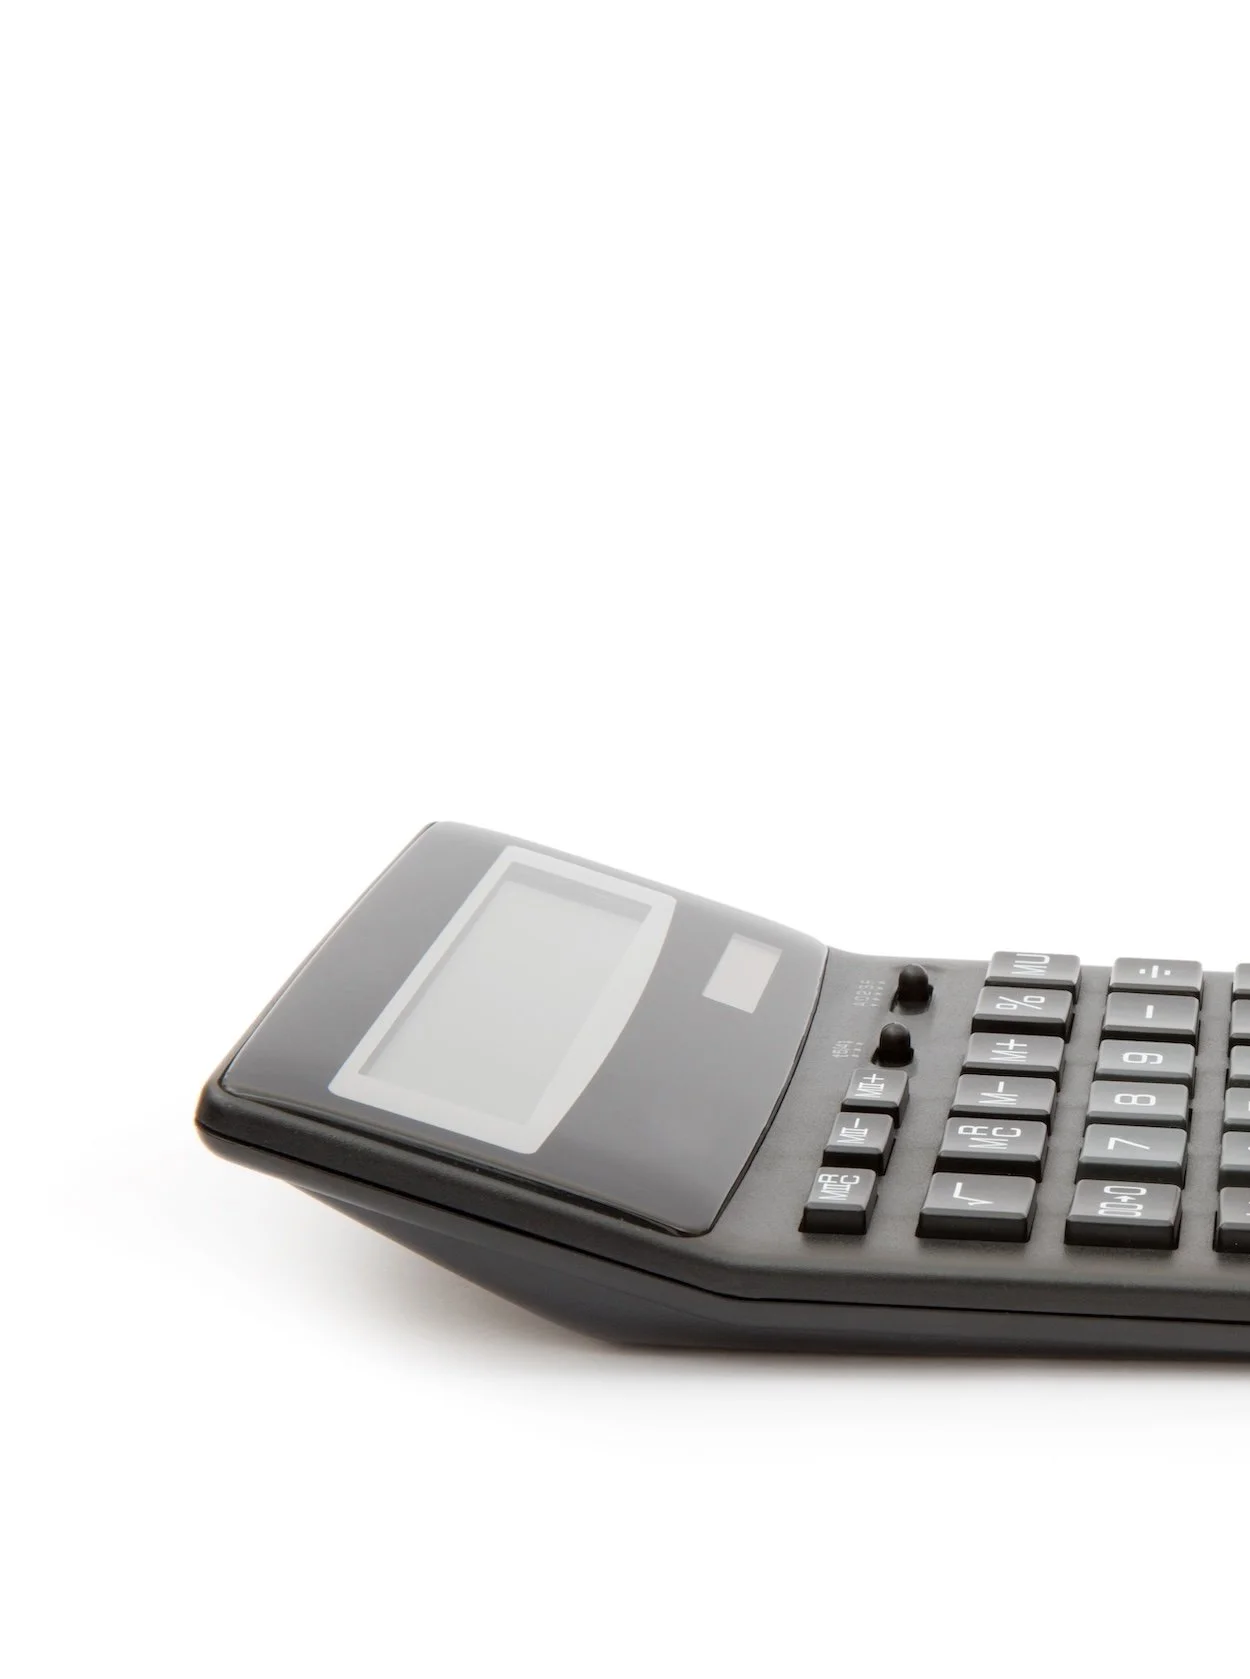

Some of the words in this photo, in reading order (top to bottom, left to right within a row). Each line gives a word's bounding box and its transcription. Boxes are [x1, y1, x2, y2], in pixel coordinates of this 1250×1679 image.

[995, 995, 1046, 1010] %
[990, 1038, 1029, 1064] M+
[1123, 1052, 1164, 1065] 9
[980, 1081, 1019, 1106] M-
[1114, 1093, 1157, 1107] 8
[1108, 1137, 1151, 1150] 7
